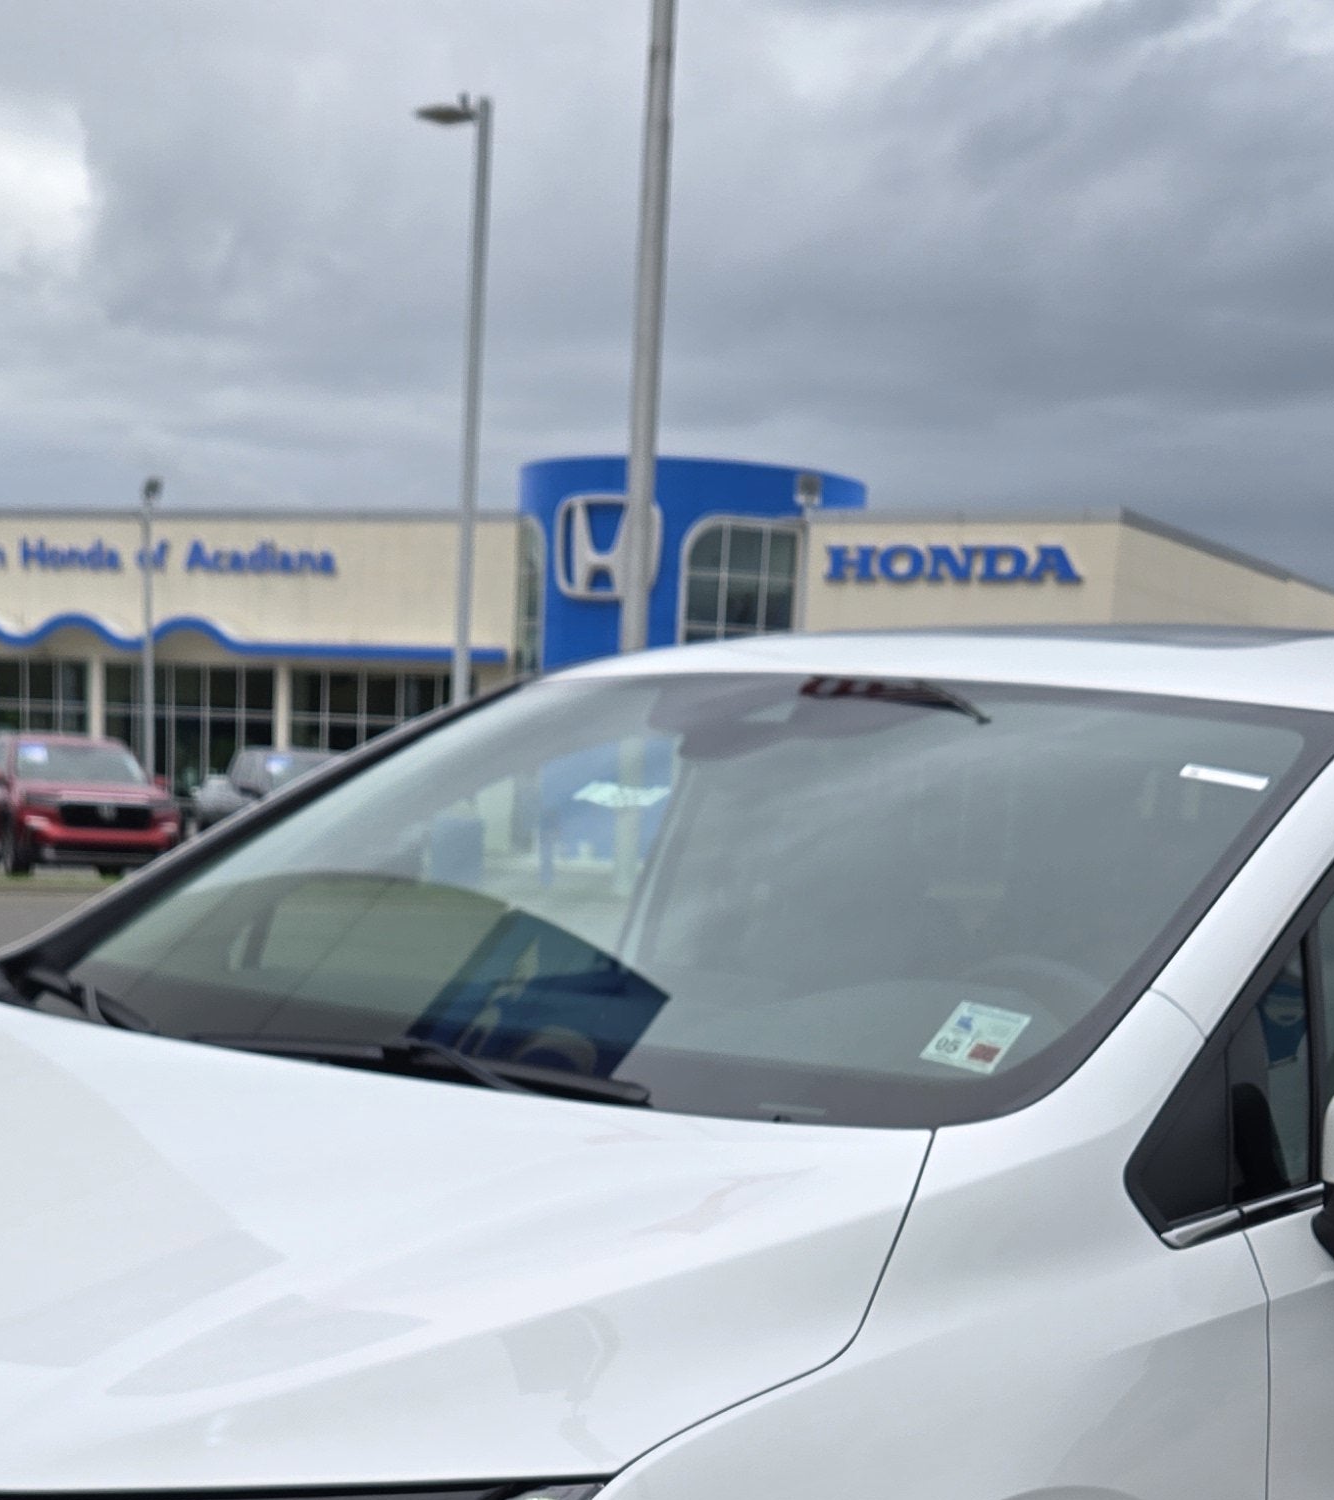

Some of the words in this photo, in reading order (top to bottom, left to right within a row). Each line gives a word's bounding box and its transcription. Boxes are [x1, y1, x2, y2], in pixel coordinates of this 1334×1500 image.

[20, 536, 122, 572] Honda
[135, 540, 169, 573] of
[186, 539, 337, 577] Acadiana
[824, 544, 1083, 586] HONDA
